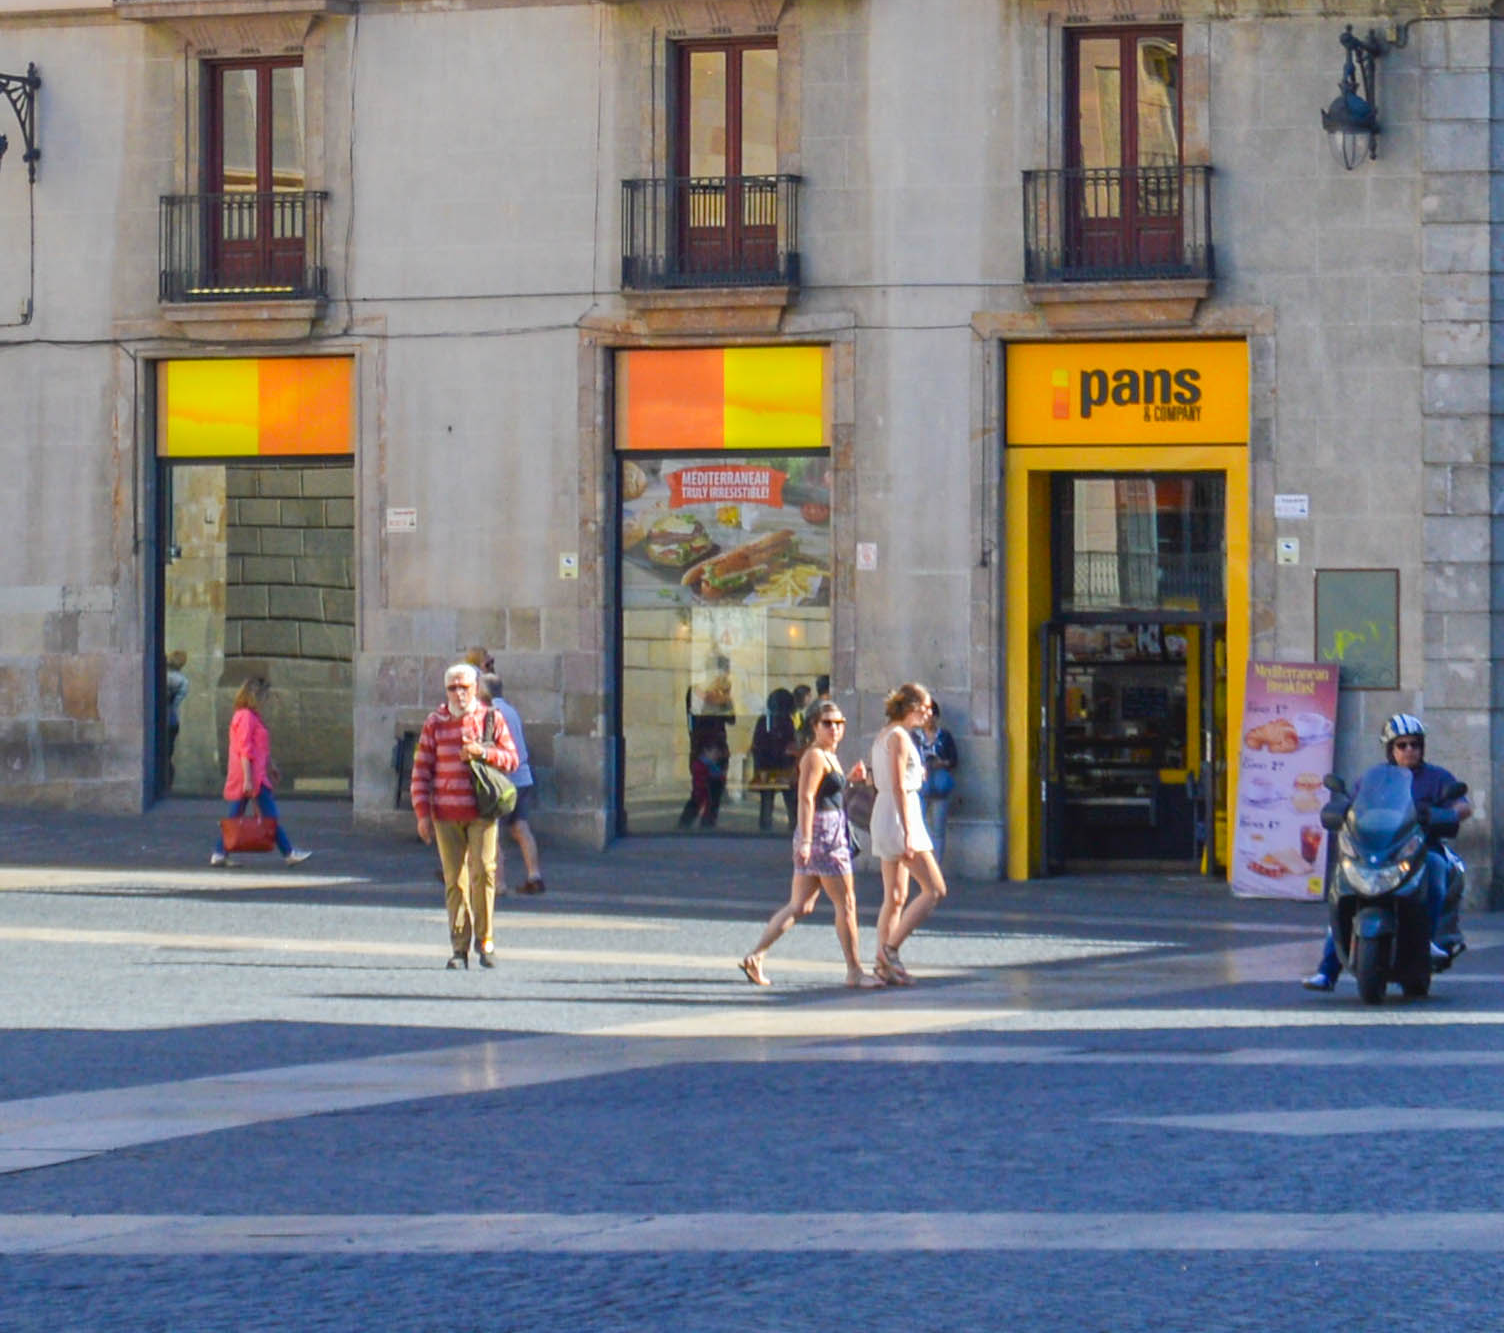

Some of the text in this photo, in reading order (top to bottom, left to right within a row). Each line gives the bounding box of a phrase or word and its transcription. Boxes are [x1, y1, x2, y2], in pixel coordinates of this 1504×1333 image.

[1080, 368, 1202, 419] pans
[1143, 405, 1202, 422] & COMPANY
[682, 471, 770, 485] MEDITERRANEAN
[682, 486, 708, 499] TRULY
